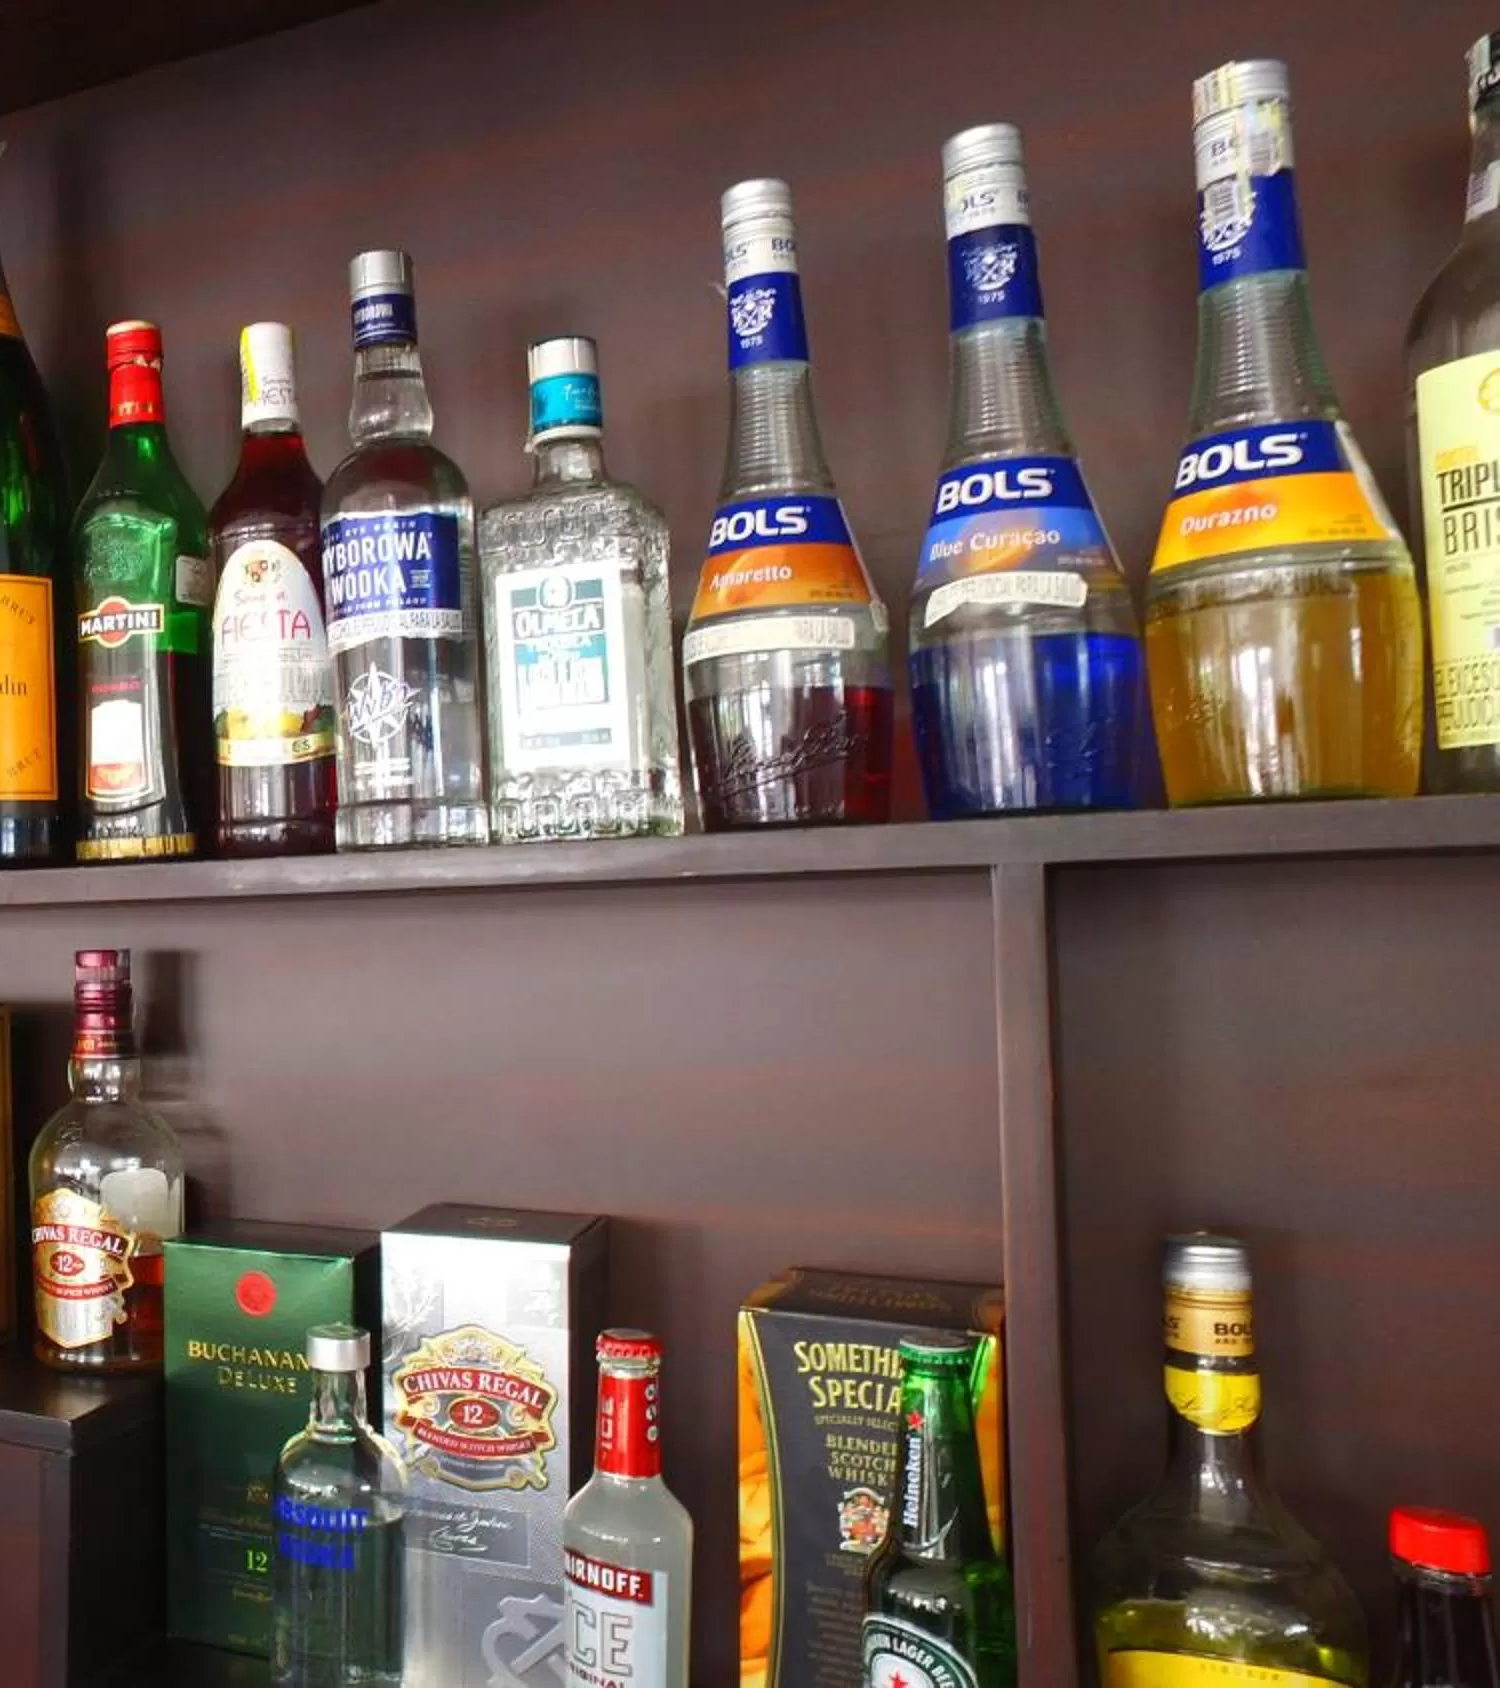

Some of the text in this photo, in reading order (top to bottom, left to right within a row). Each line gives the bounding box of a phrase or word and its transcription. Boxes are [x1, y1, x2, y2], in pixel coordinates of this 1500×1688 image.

[1174, 432, 1303, 490] BOLS
[935, 467, 1053, 515] BOLS
[1436, 459, 1500, 505] TRIPL
[708, 505, 808, 548] BOLS
[1180, 503, 1278, 537] Durazno
[929, 529, 1061, 563] Blue Curaçao
[331, 564, 407, 605] WODKA
[709, 564, 793, 591] Amaretto
[80, 610, 158, 637] MARTINI
[221, 608, 311, 646] FIETA
[68, 1227, 123, 1256] REGAL
[57, 1255, 73, 1273] 12
[1213, 1321, 1252, 1337] BOL
[794, 1341, 905, 1380] SOMETHI
[402, 1371, 543, 1409] CHIVAS REGAL
[808, 1375, 902, 1417] SPECIA
[463, 1405, 484, 1425] 12
[825, 1433, 897, 1456] BLENDE
[831, 1452, 896, 1473] SCOTCH
[828, 1466, 895, 1487] WHISK
[903, 1436, 922, 1530] Heineken
[246, 1550, 269, 1572] 12
[564, 1551, 642, 1597] IRNOFF
[571, 1599, 634, 1679] CE
[891, 1636, 936, 1670] LAGER
[931, 1663, 957, 1688] BEE
